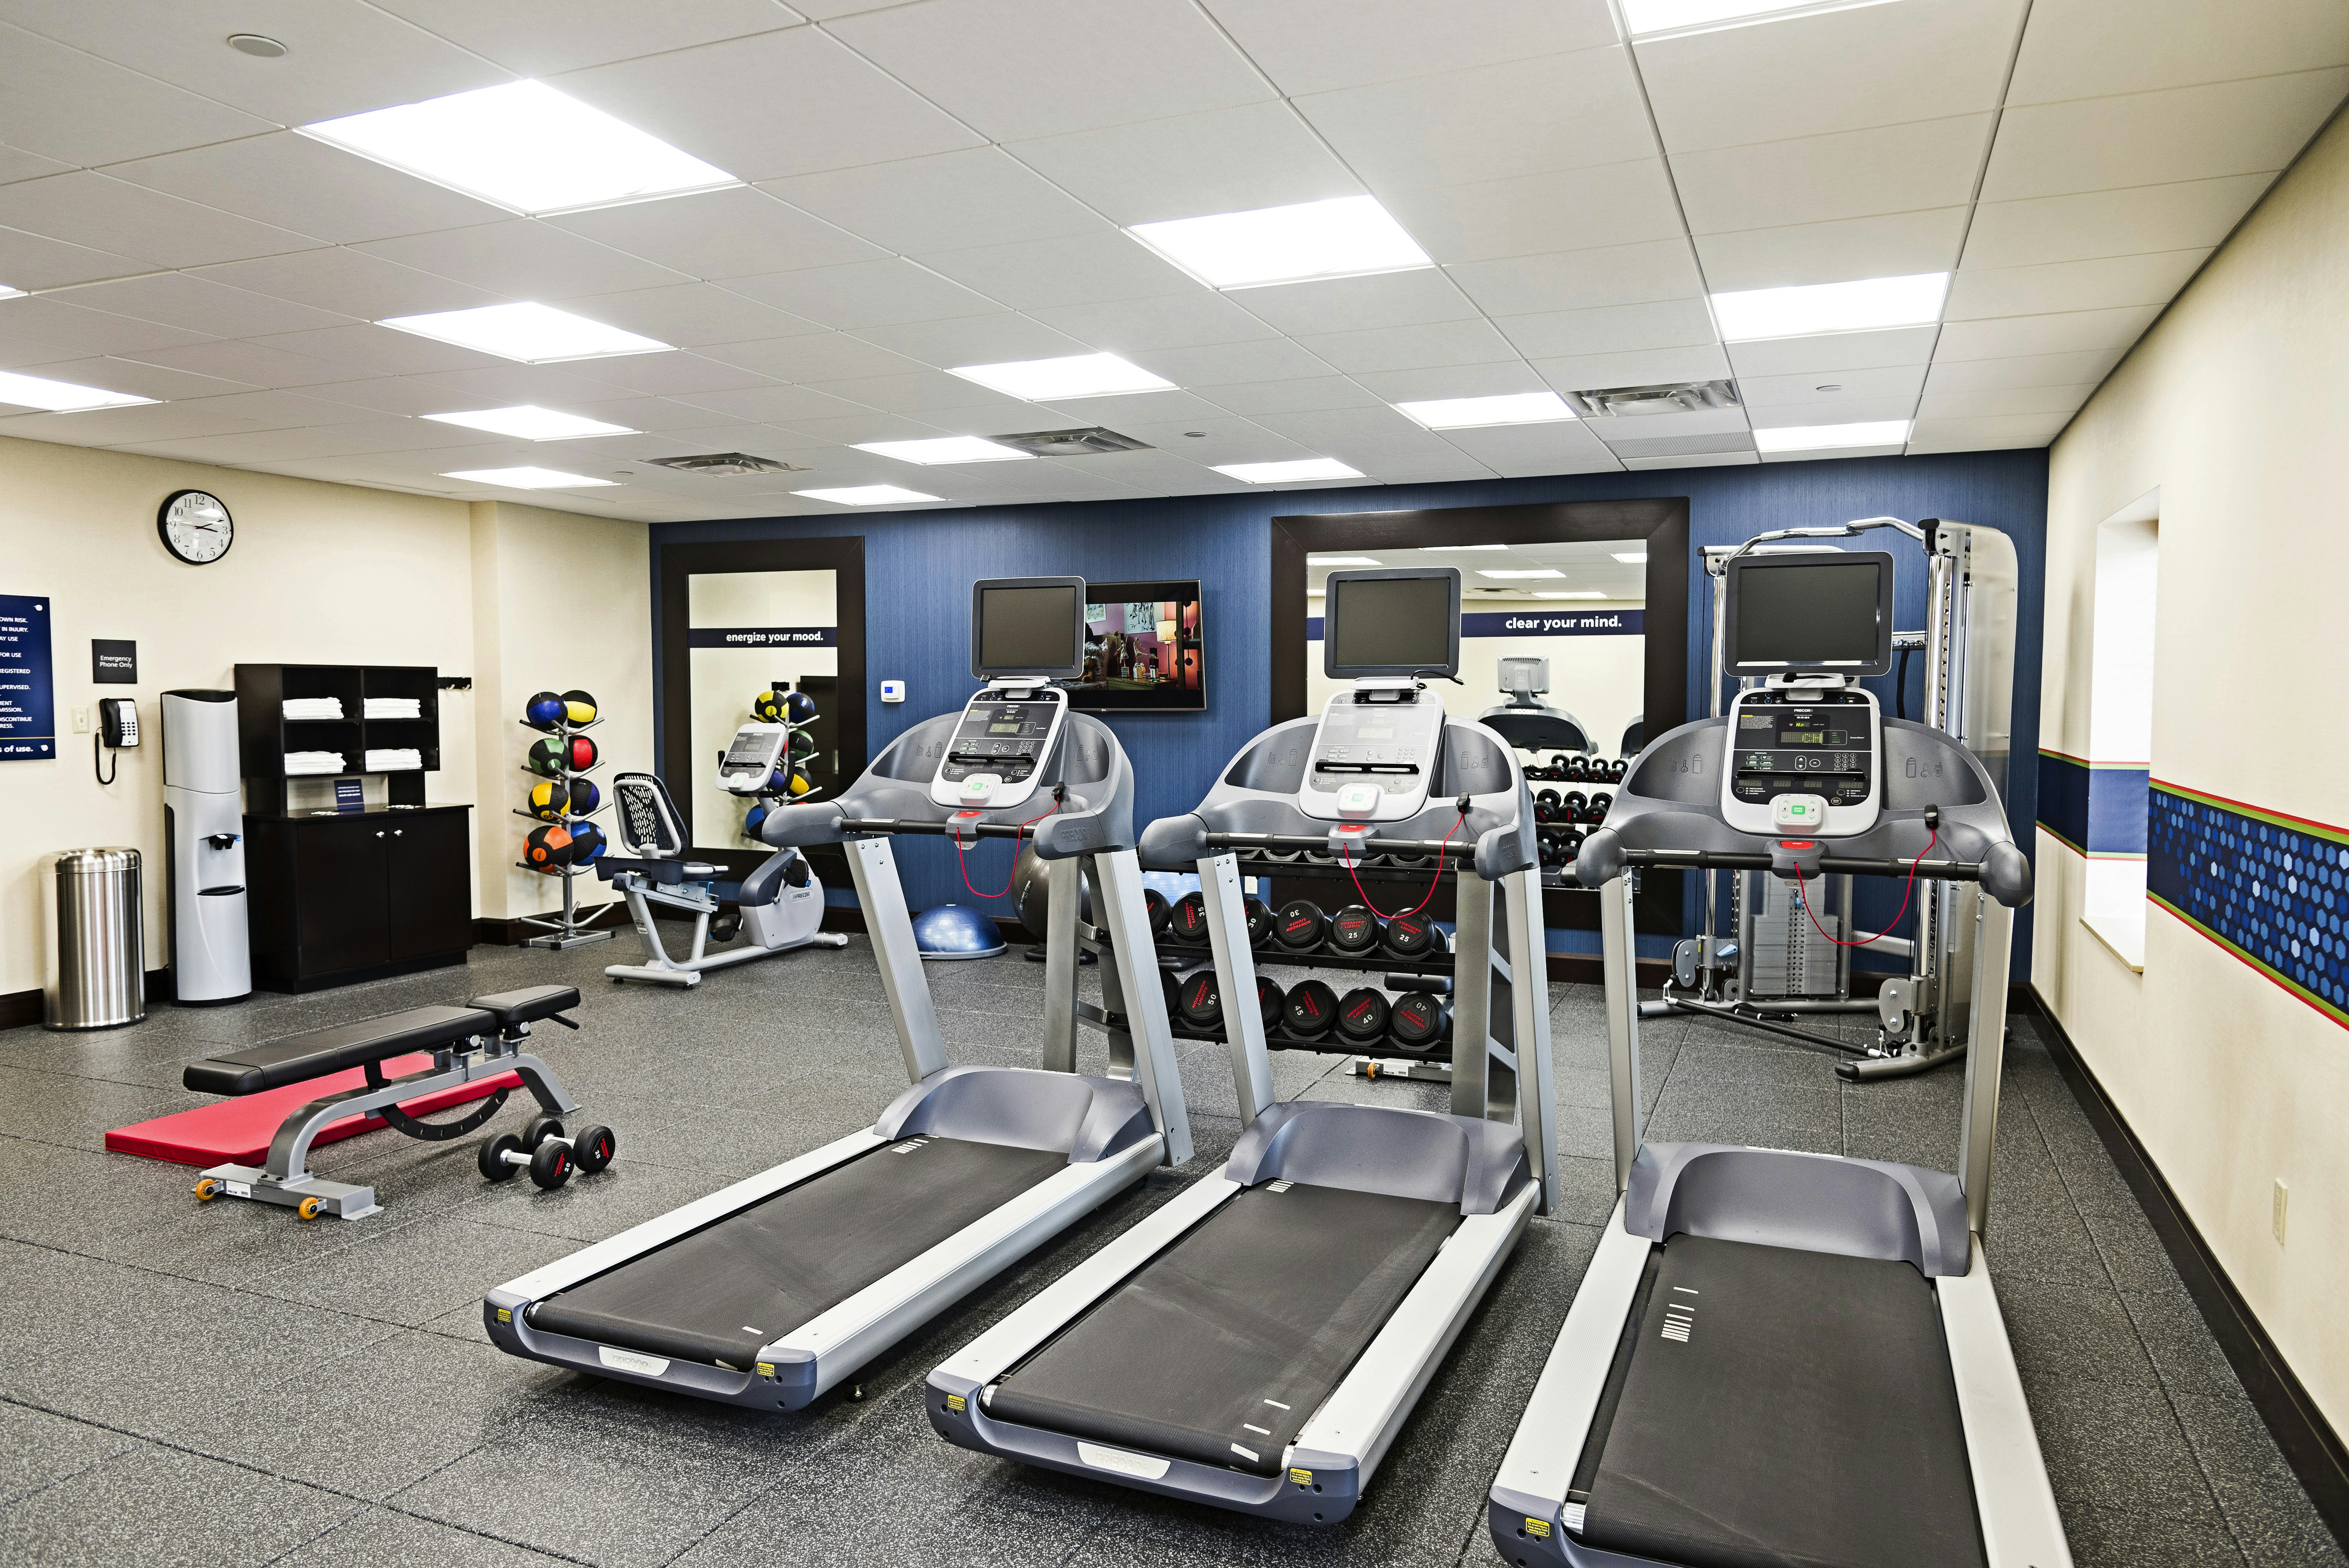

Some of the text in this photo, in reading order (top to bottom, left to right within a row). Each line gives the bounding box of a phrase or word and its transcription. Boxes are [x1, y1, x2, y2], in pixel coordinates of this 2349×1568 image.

[184, 499, 193, 508] 11
[195, 495, 204, 504] 12
[174, 506, 183, 516] 10
[170, 520, 176, 529] 9
[223, 526, 228, 535] 3
[174, 534, 180, 543] 8
[218, 539, 224, 547] 4
[185, 545, 189, 554] 7
[197, 550, 202, 559] 6
[210, 548, 215, 556] 5
[1506, 615, 1622, 631] clear your mind.
[726, 631, 823, 643] energize your mood.
[1198, 907, 1205, 917] 35
[1248, 918, 1256, 928] 30
[1287, 920, 1311, 932] NORTHERN
[1289, 918, 1306, 927] LIGHTS
[1399, 920, 1422, 933] NORTHERN
[1401, 925, 1416, 934] LIGHTS
[1192, 980, 1206, 1009] NORTHERN
[1198, 987, 1208, 1006] LIGHTS
[1208, 994, 1217, 1005] 50
[1303, 997, 1313, 1014] LIGHTS
[1305, 990, 1320, 1016] NORTHERN
[1347, 998, 1371, 1018] NORTHERN
[1416, 1002, 1427, 1011] 40
[1295, 1006, 1303, 1015] 45
[1353, 1004, 1369, 1018] LIGHTS
[1364, 1015, 1373, 1024] 40
[1400, 1010, 1426, 1029] NORTHERN
[1407, 1010, 1424, 1023] LIGHTS
[595, 1150, 601, 1158] 20
[565, 1163, 570, 1172] 20
[612, 1354, 648, 1371] PRECOR
[1095, 1451, 1144, 1472] PRECOR
